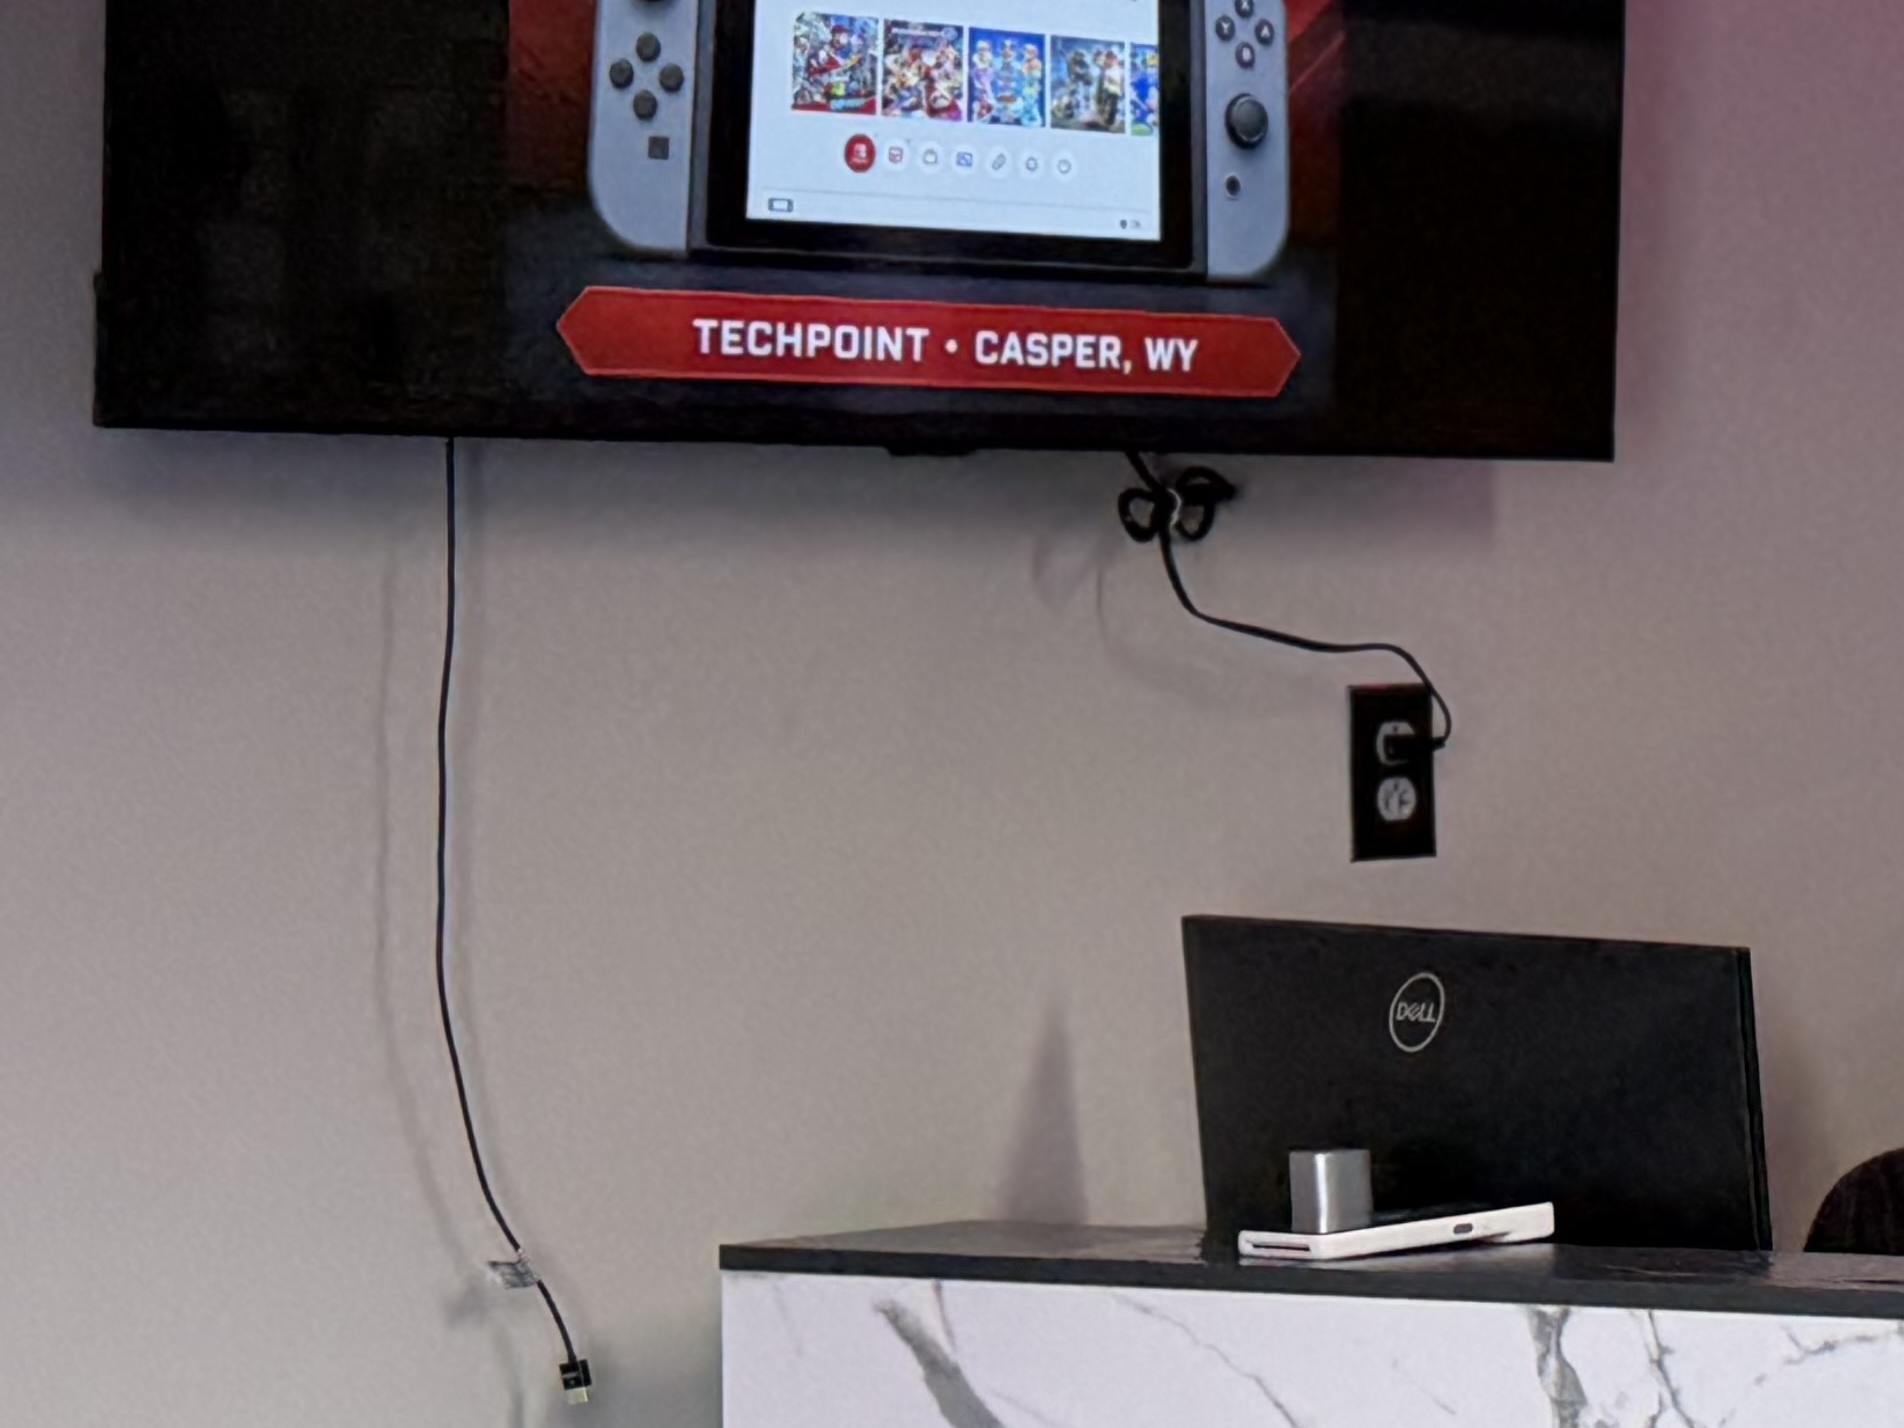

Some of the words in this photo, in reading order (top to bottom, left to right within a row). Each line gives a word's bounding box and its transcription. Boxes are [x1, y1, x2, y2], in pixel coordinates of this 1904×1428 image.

[693, 319, 929, 362] TECHPOINT
[974, 330, 1133, 375] CASPER,
[1145, 338, 1198, 372] WY
[1396, 1002, 1436, 1022] DELL
